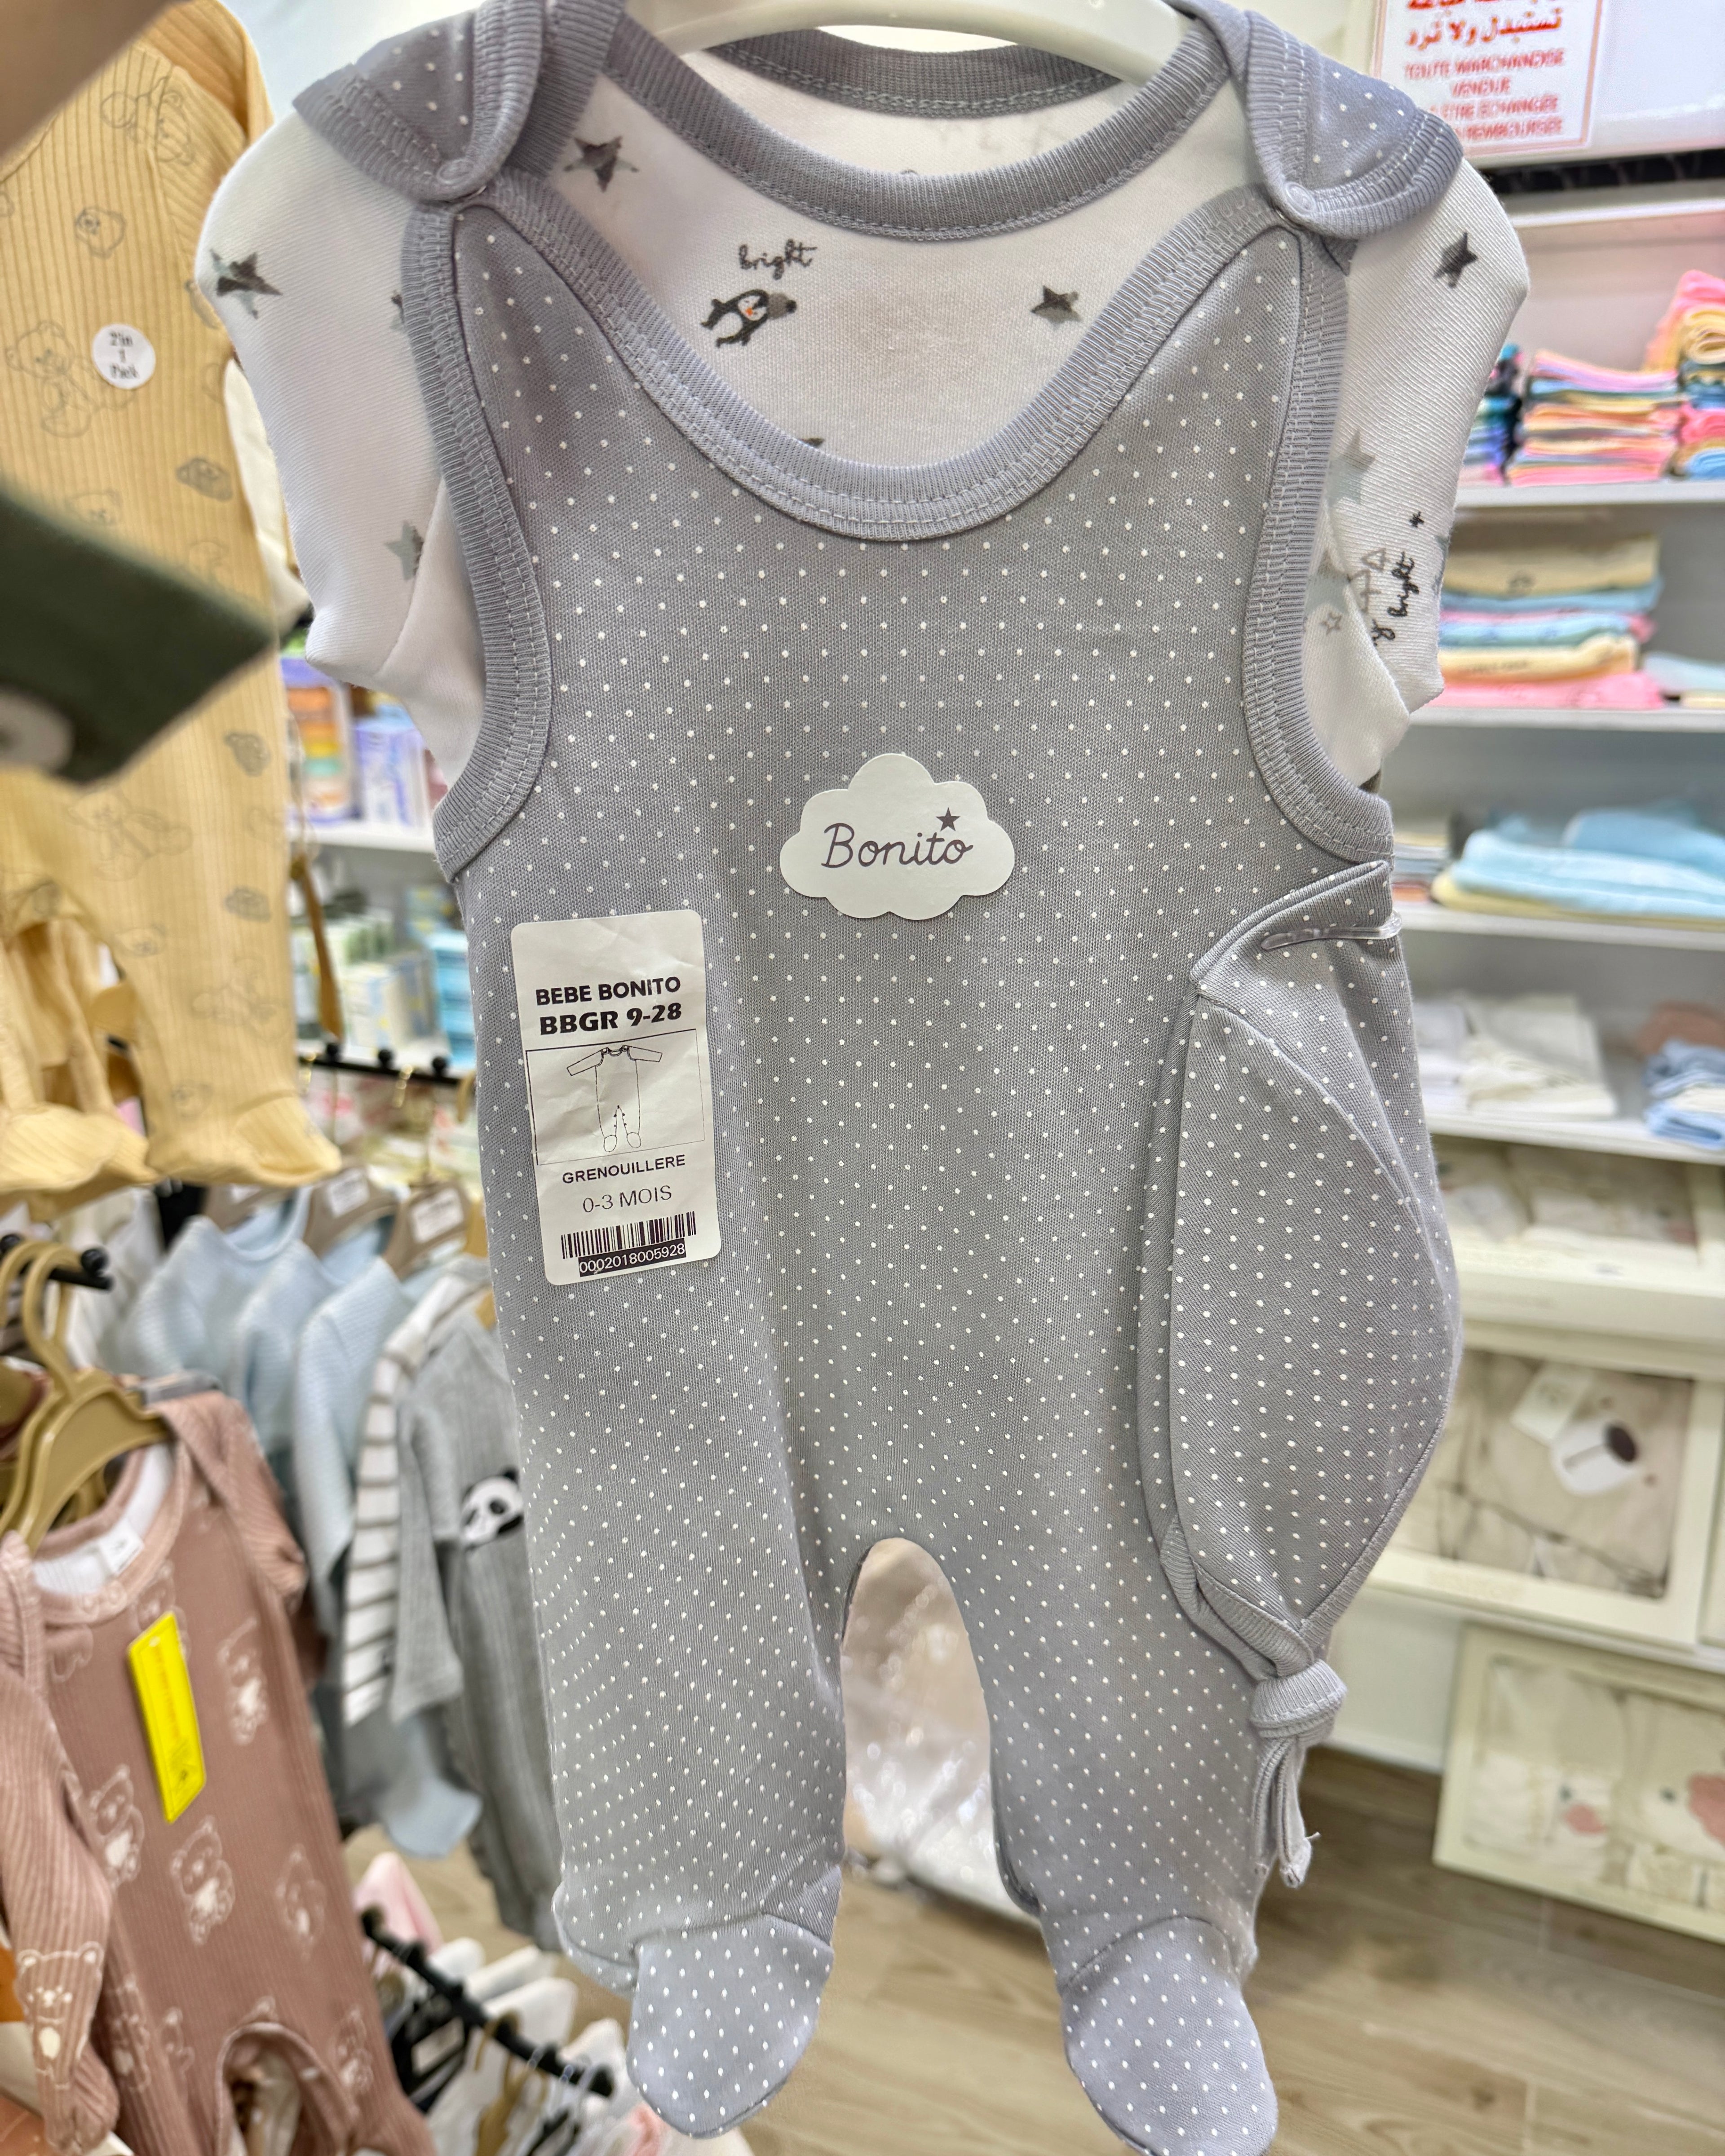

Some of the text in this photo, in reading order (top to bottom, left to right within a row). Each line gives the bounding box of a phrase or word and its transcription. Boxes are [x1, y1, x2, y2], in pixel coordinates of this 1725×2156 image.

[739, 238, 818, 281] bright
[1387, 551, 1420, 617] bright
[821, 822, 974, 869] Bonito
[535, 976, 681, 1006] BEBE BONITO
[540, 1002, 682, 1035] BBGR 9-28
[562, 1154, 686, 1184] GRENOUILLERE
[583, 1185, 672, 1213] 0-3 MOIS
[579, 1243, 686, 1273] 0002018005928
